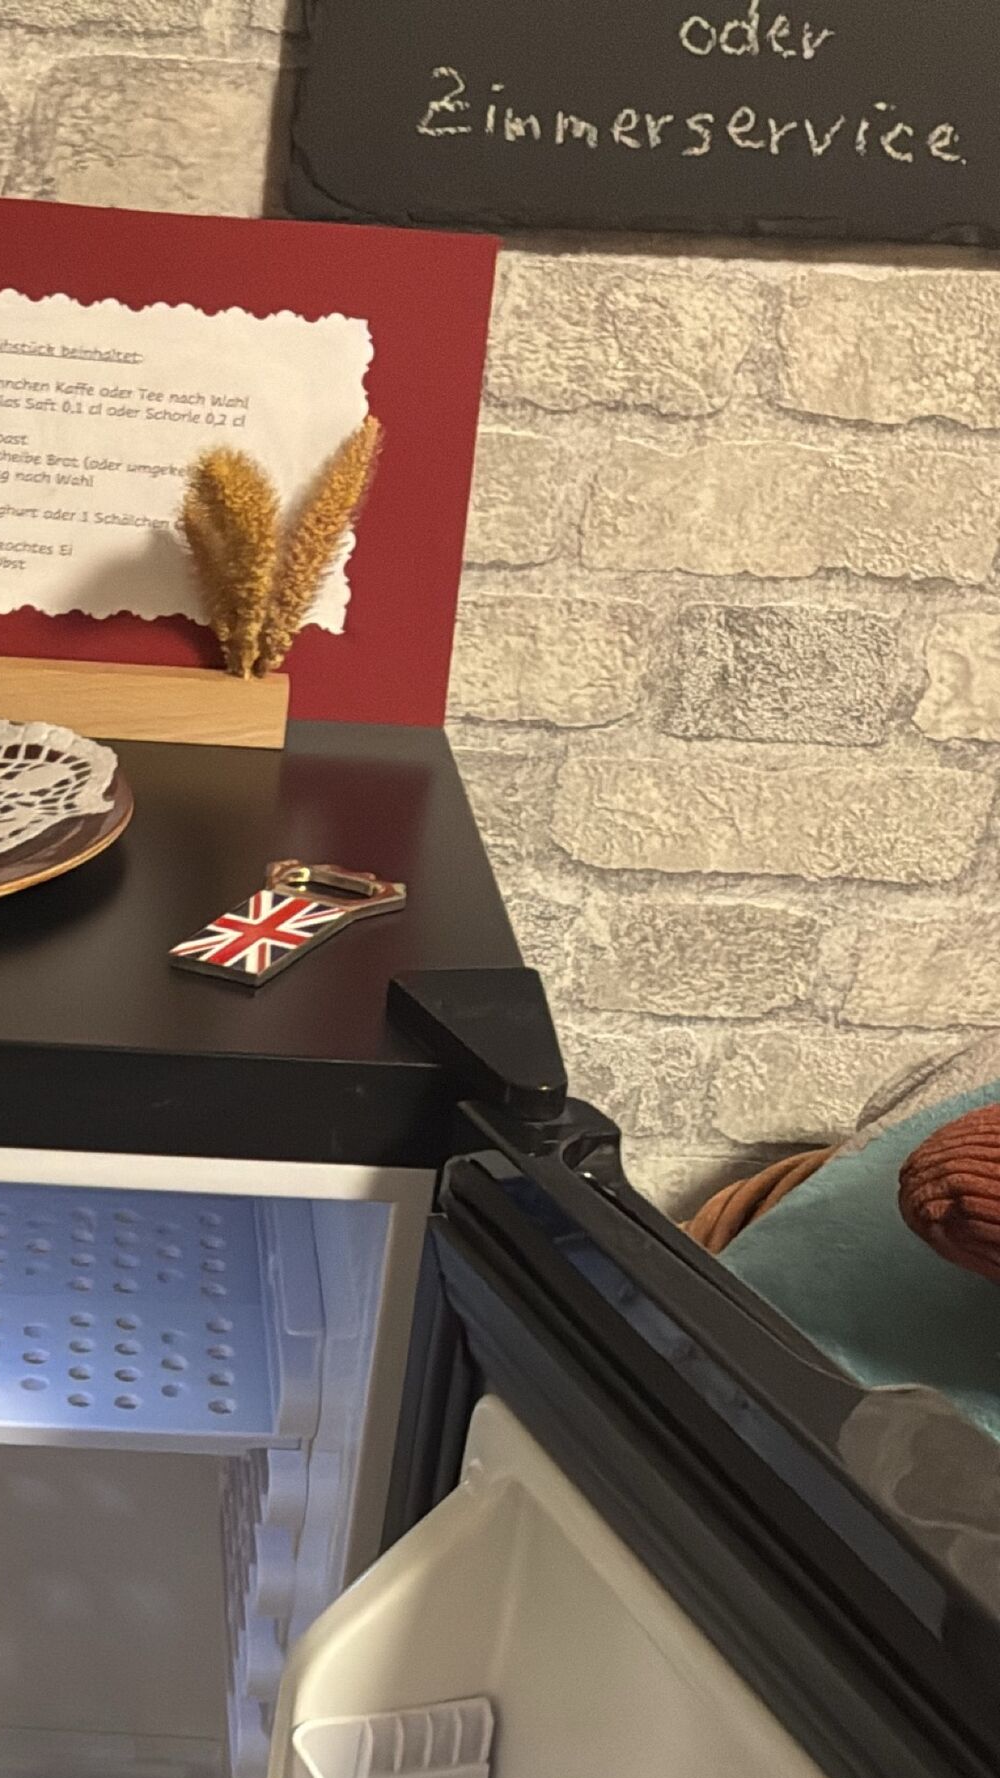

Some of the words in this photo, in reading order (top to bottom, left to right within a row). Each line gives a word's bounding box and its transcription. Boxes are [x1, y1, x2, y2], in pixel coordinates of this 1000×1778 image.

[679, 0, 835, 59] oder
[416, 66, 966, 165] Zimmerservice
[99, 385, 133, 399] oder
[137, 388, 164, 402] Tee
[169, 392, 205, 406] nach
[210, 395, 250, 409] Wahl
[25, 397, 56, 411] Saft
[106, 405, 140, 418] oder
[145, 408, 200, 424] Schorle
[46, 454, 80, 468] Brot
[83, 455, 122, 471] (oder
[15, 471, 51, 484] nach
[55, 473, 94, 488] Wahl
[43, 508, 76, 522] oder
[80, 511, 89, 522] 1
[58, 543, 73, 556] Ei
